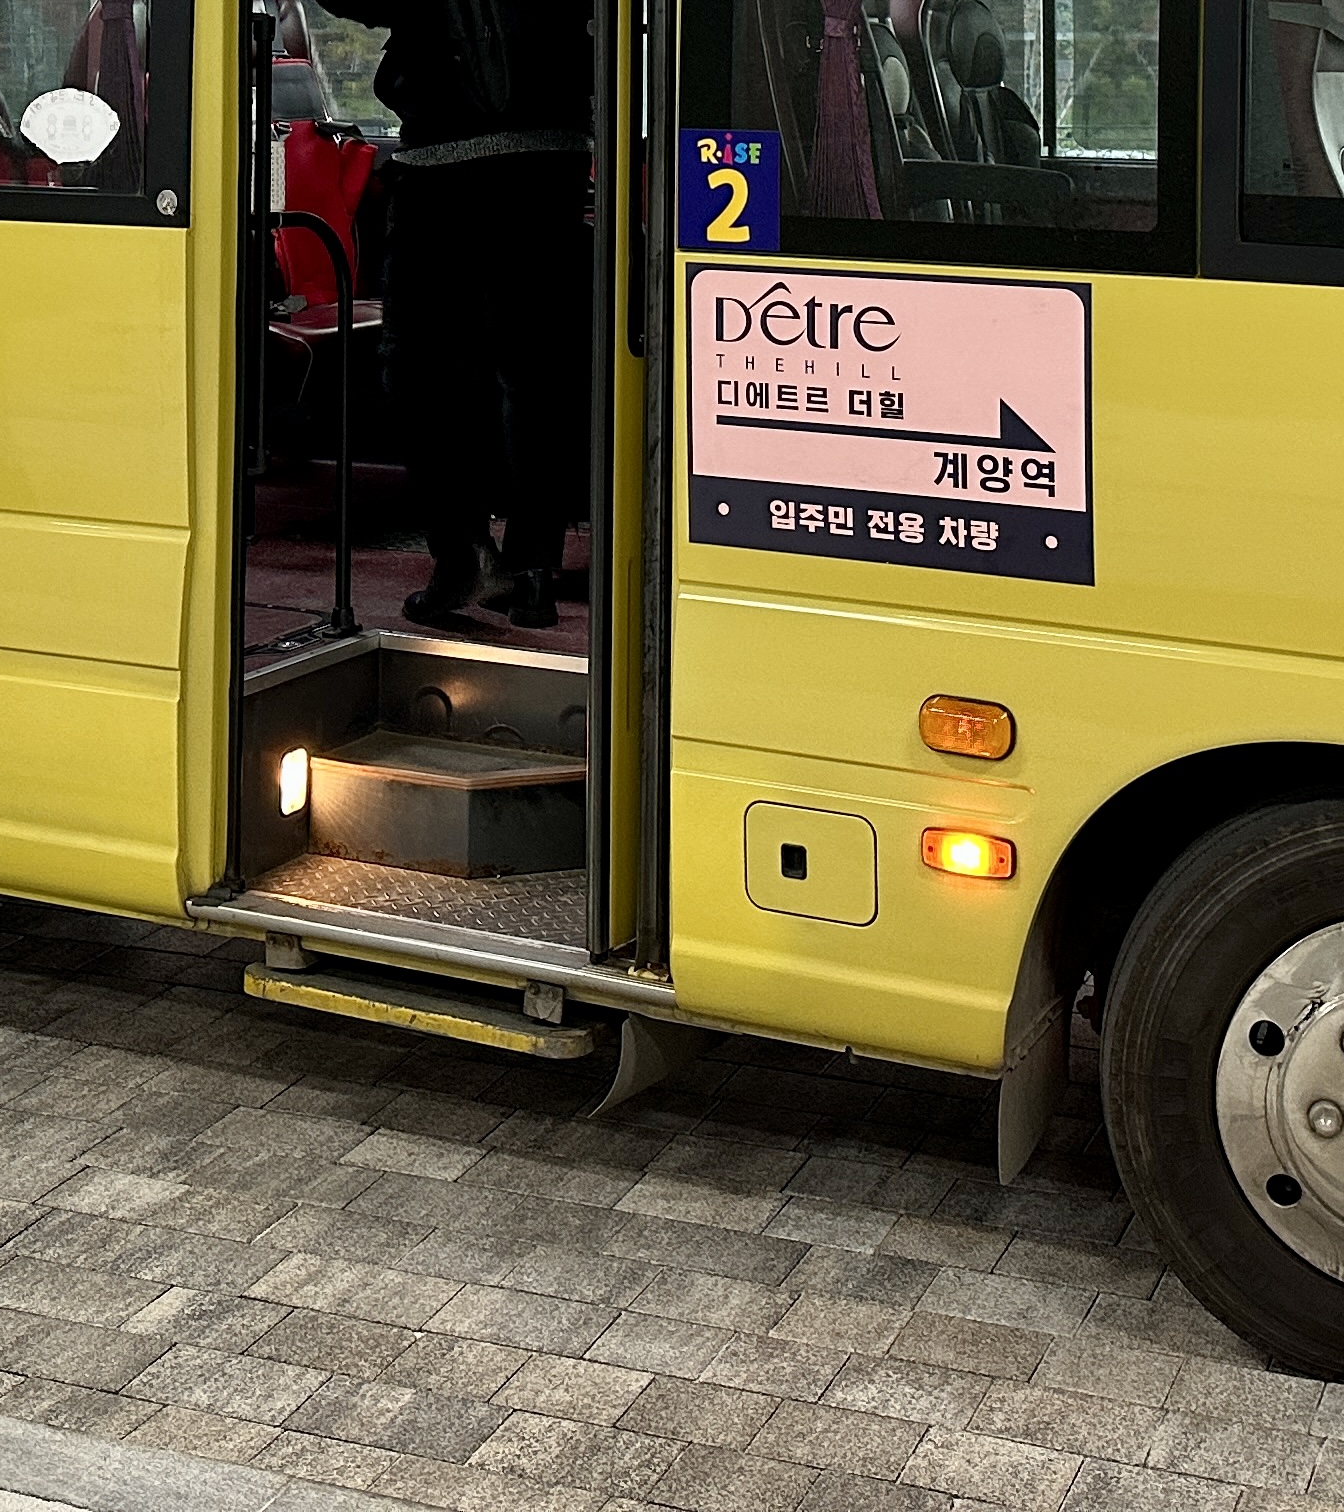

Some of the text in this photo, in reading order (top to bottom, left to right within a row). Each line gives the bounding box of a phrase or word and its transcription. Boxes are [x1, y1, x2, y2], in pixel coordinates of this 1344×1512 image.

[706, 168, 751, 243] 2
[717, 380, 904, 420] 디에트르 더힐
[933, 451, 1055, 497] 계양역
[769, 499, 1000, 551] 입주민 전용 차량
